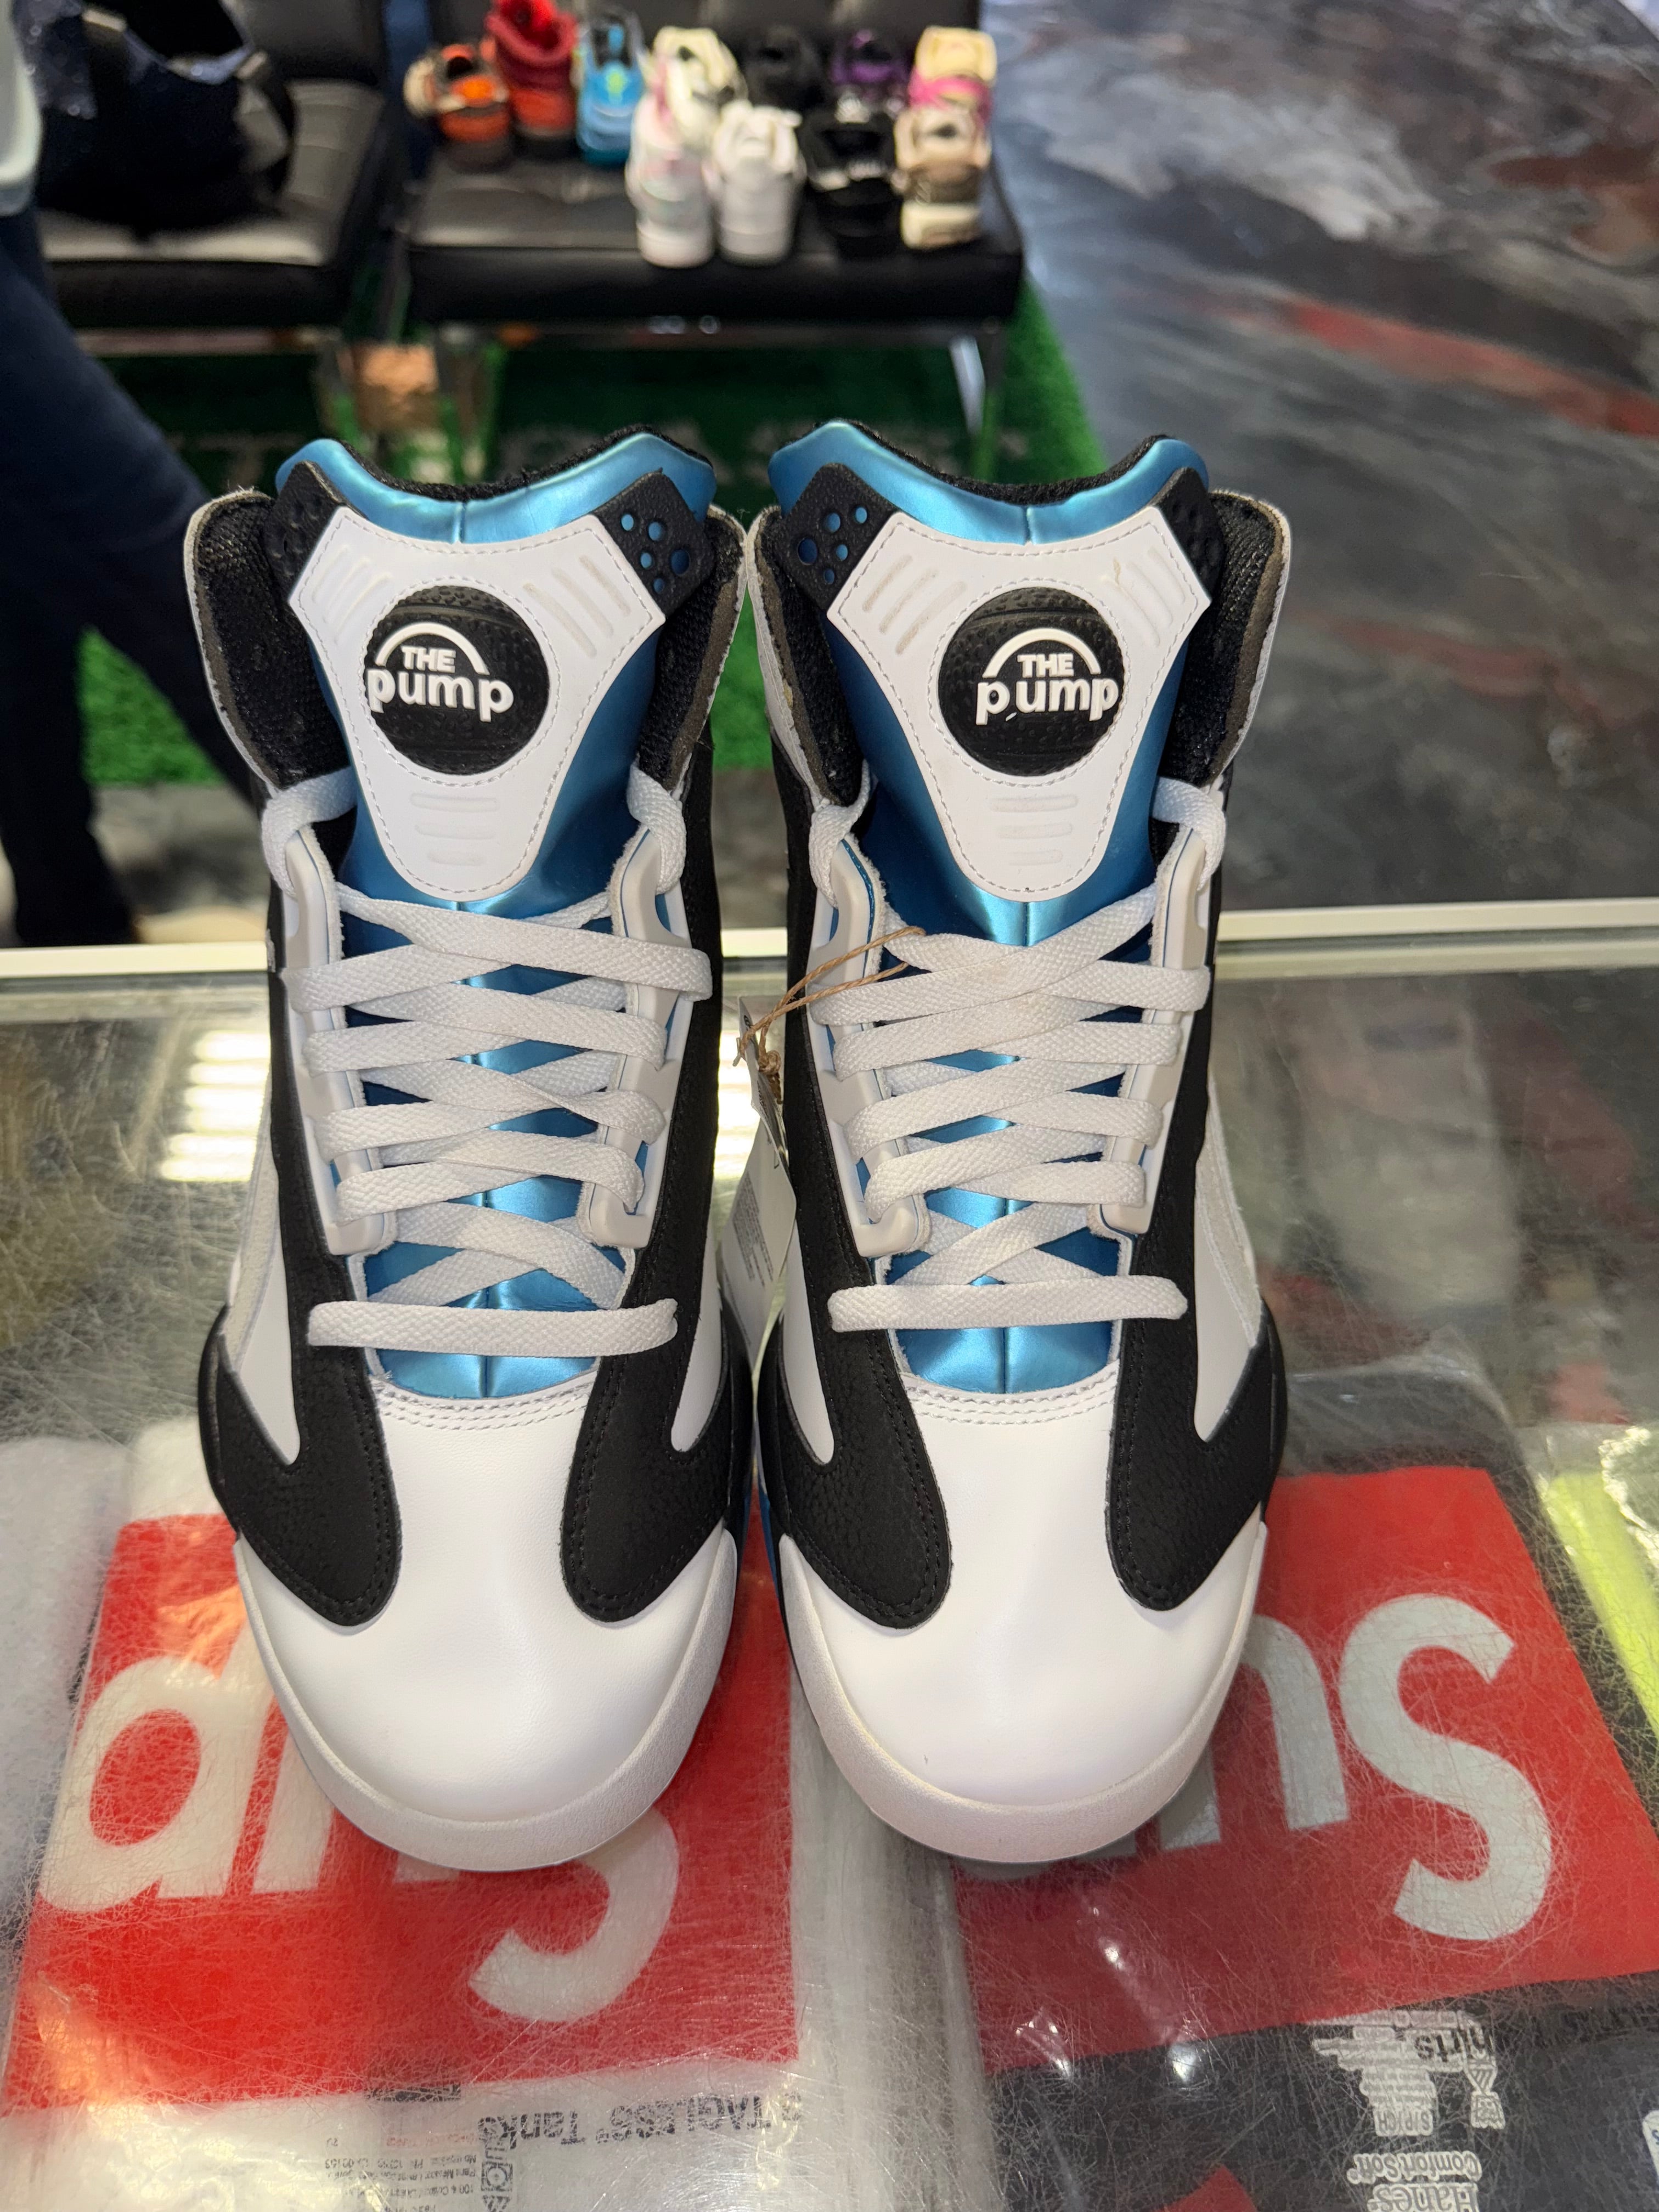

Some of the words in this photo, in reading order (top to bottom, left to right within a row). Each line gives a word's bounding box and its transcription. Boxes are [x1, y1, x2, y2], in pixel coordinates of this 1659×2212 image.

[402, 646, 456, 674] THE
[1017, 653, 1075, 678] THE
[367, 668, 515, 723] pump
[975, 678, 1119, 725] pump
[1400, 2153, 1480, 2180] Comfort
